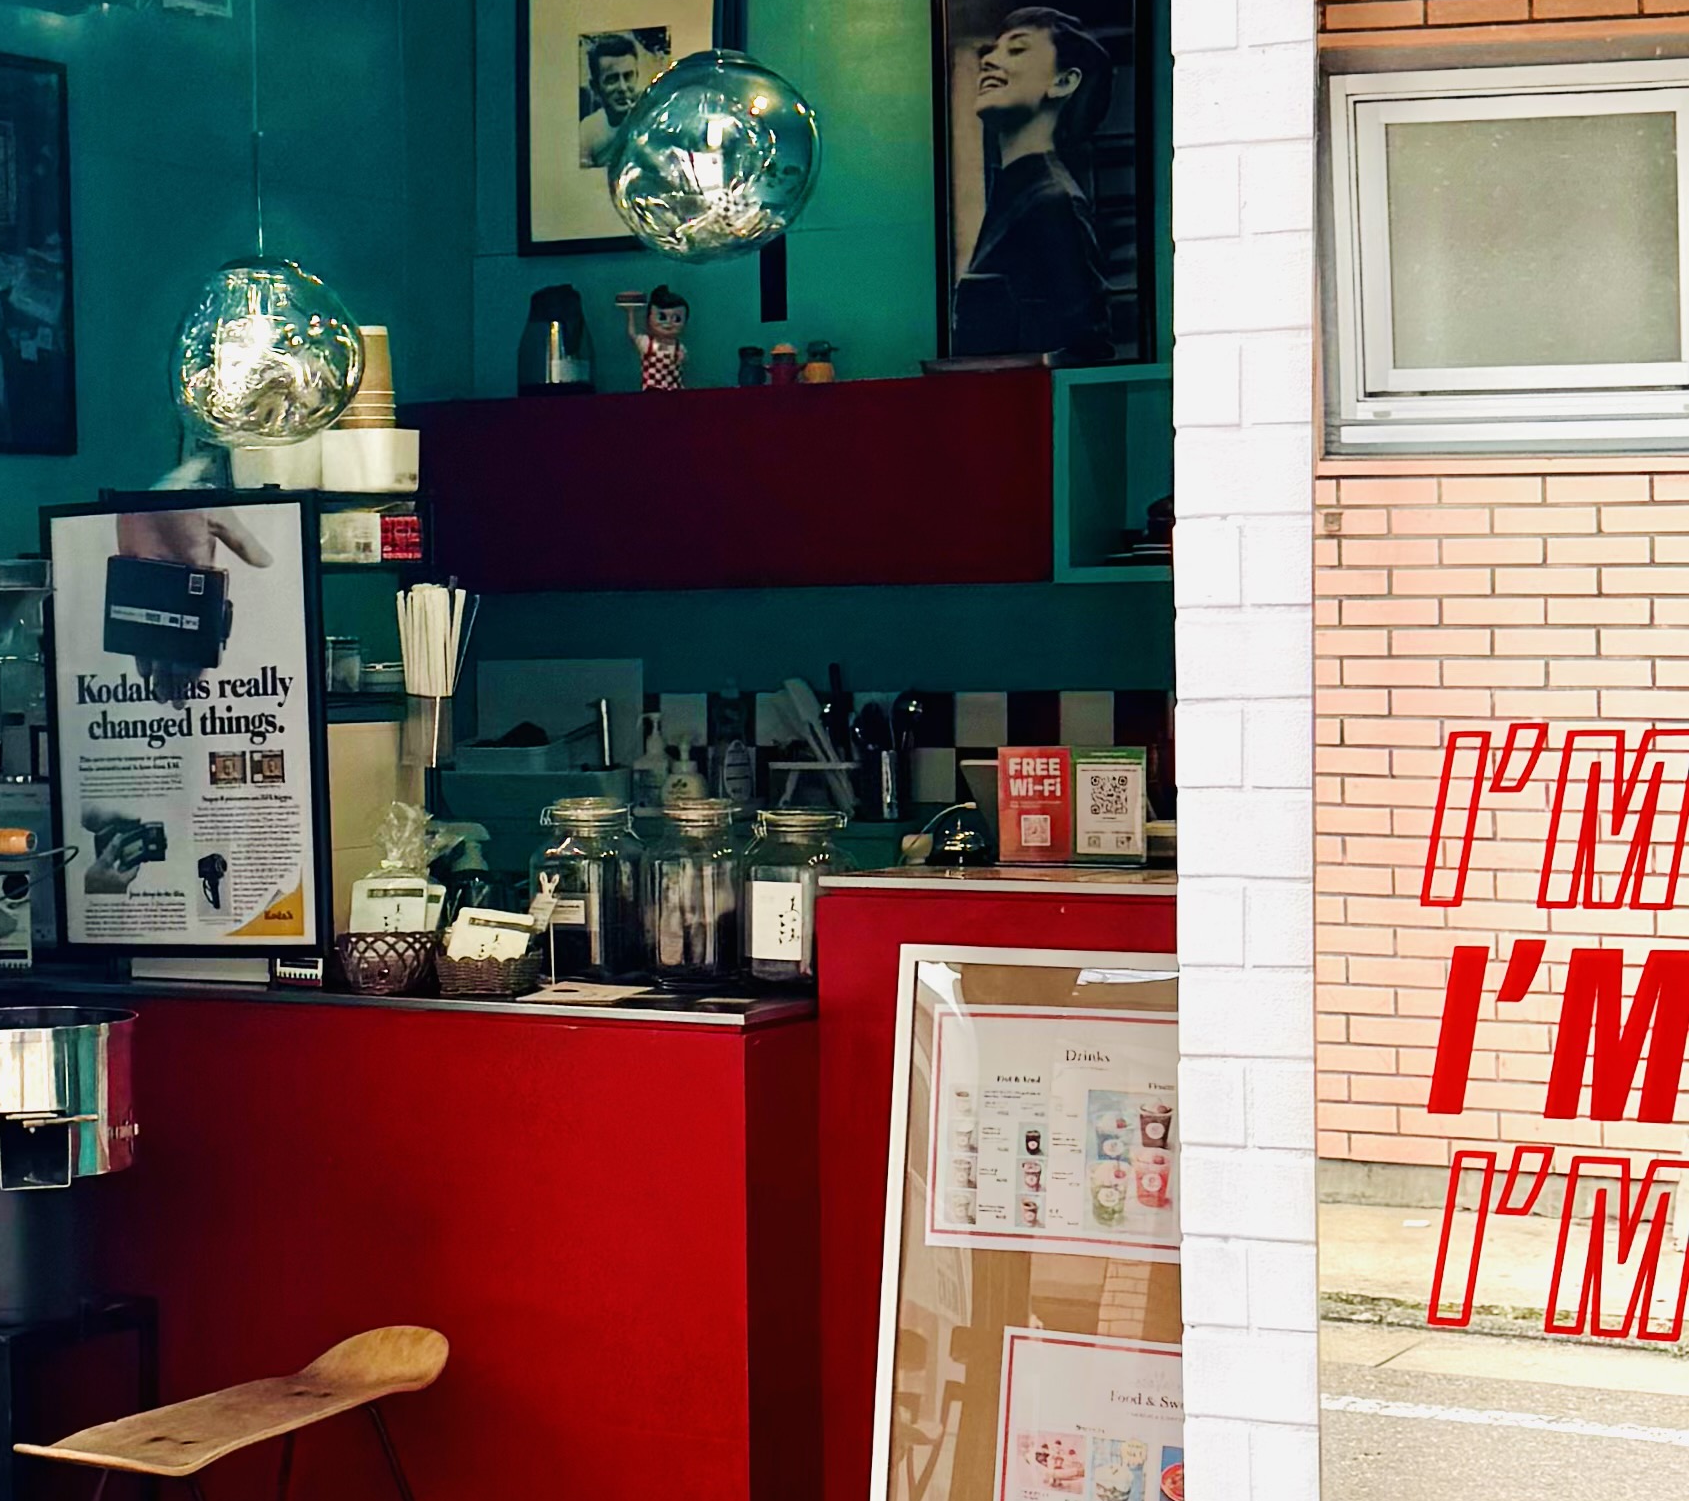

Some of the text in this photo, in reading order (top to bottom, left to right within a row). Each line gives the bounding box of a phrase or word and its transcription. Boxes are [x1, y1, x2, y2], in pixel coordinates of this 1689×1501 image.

[217, 665, 293, 708] really
[88, 705, 285, 749] changed things.
[1008, 757, 1061, 776] FREE
[1009, 777, 1061, 797] Wi-Fi
[1065, 1049, 1110, 1062] Drinks
